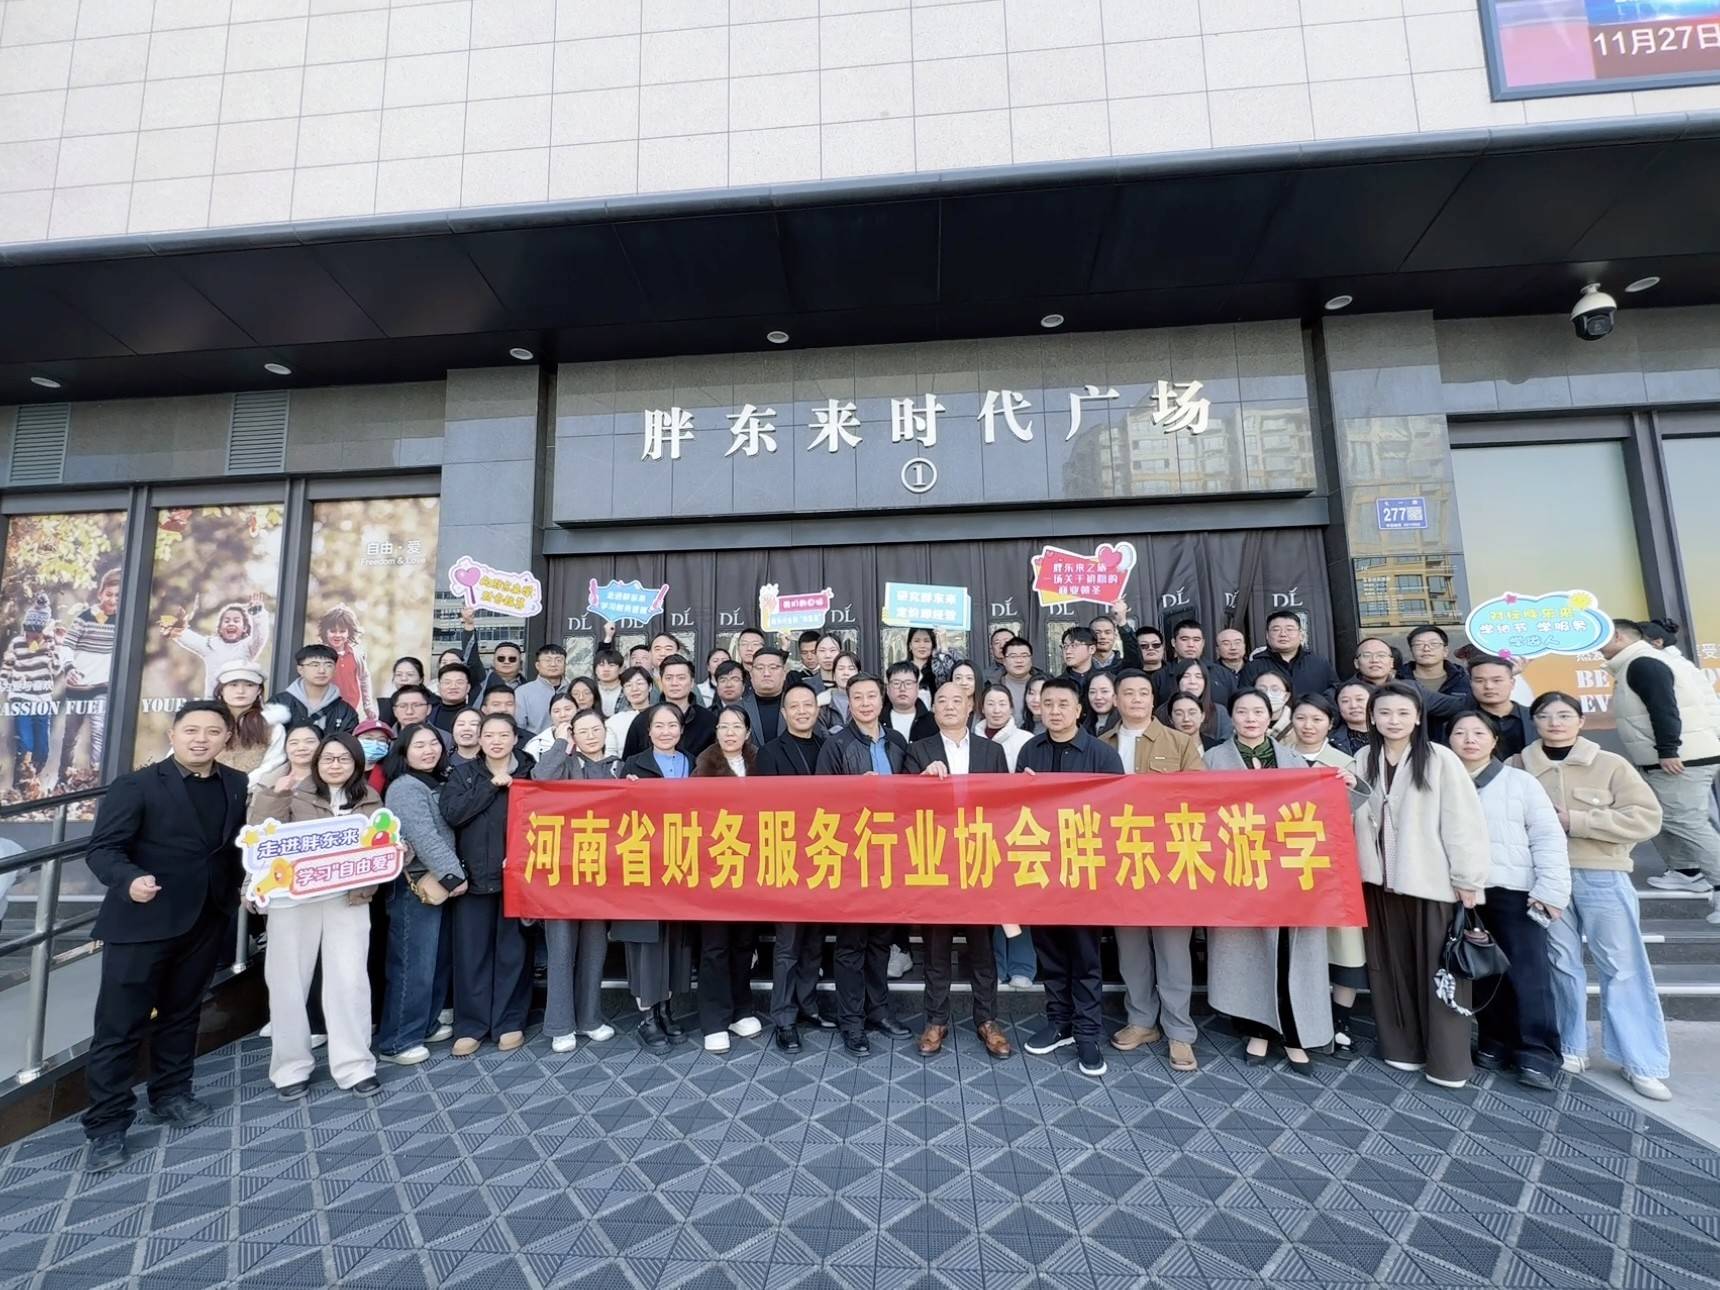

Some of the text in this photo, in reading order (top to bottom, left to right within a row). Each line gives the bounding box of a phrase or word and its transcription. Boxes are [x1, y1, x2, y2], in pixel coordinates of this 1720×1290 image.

[1594, 23, 1720, 56] 11月27日
[641, 379, 1212, 462] 胖东来时代广场
[1383, 507, 1406, 522] 277
[257, 828, 360, 859] 走进胖东来
[524, 801, 1332, 890] 河南省财务服务行业协会胖东来游学
